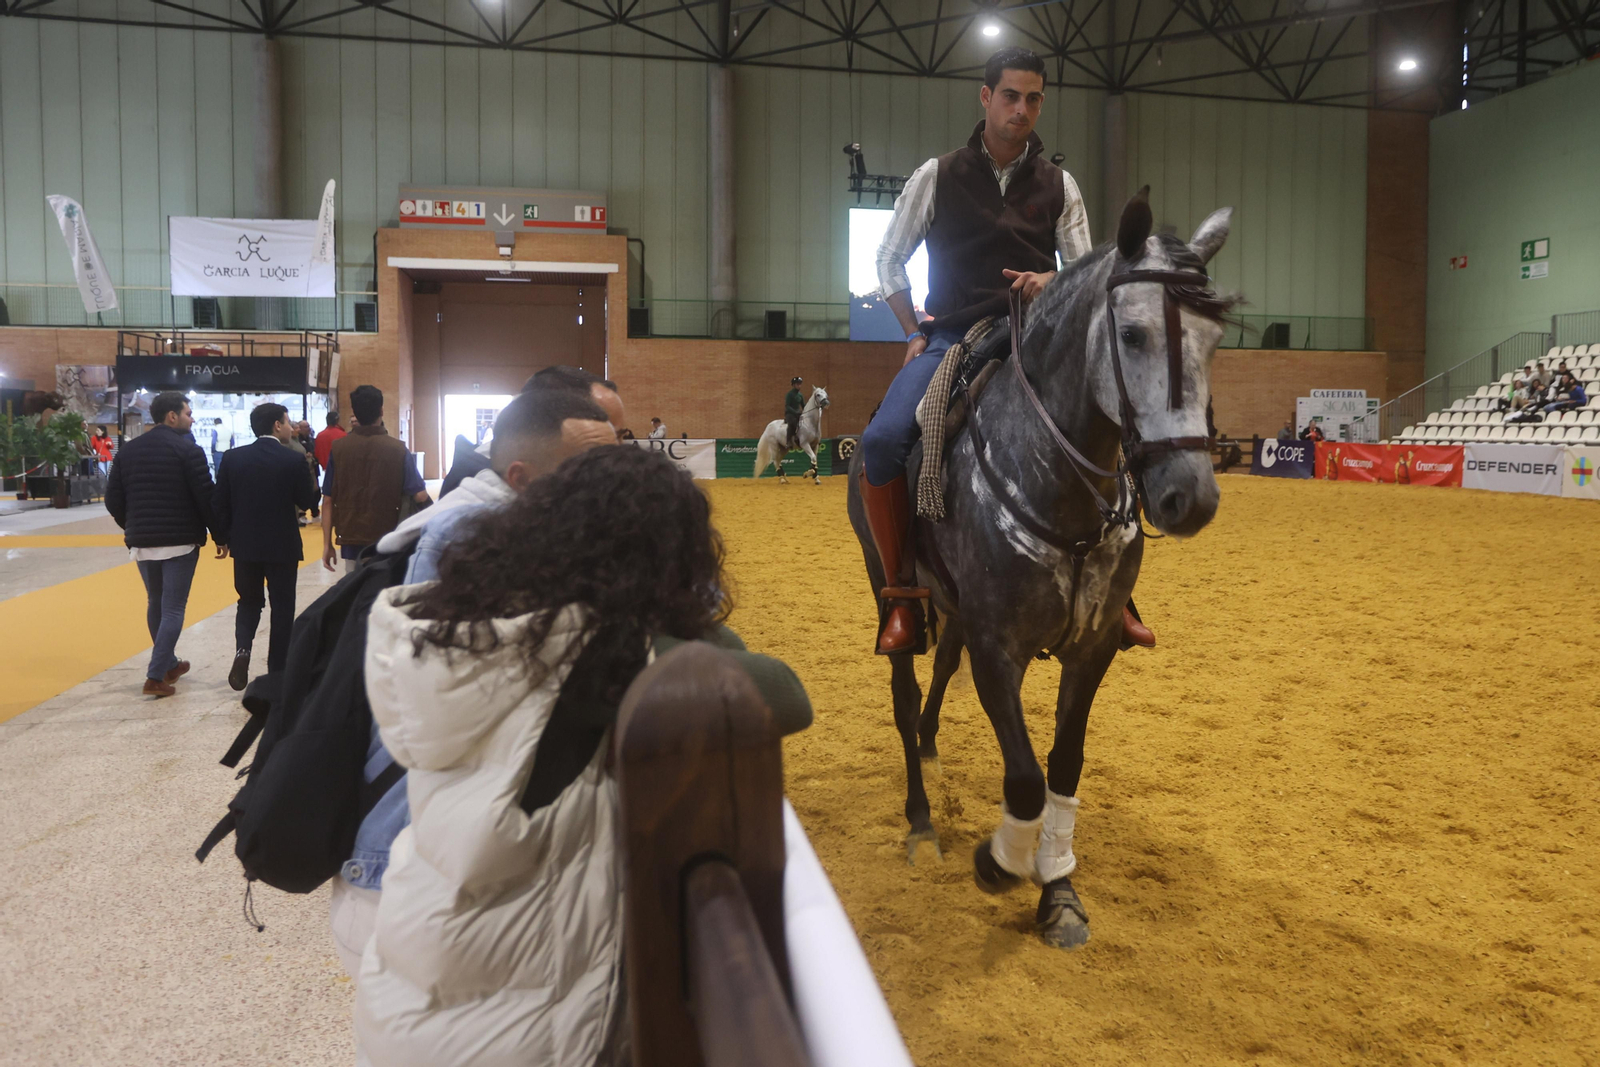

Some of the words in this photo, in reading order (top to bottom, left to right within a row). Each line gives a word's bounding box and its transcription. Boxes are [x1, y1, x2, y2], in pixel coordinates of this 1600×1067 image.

[456, 202, 466, 216] 4
[474, 203, 480, 216] 1
[203, 264, 250, 278] GARCIA
[259, 265, 300, 282] LUQUE
[185, 364, 240, 376] FRAGUA
[1313, 390, 1363, 398] CAFETERIA
[1323, 400, 1356, 412] SICAB
[1277, 445, 1306, 463] COPE
[1342, 457, 1374, 469] Cruzcampo
[1416, 460, 1454, 473] Cruzcampo
[1466, 460, 1558, 475] DEFENDER
